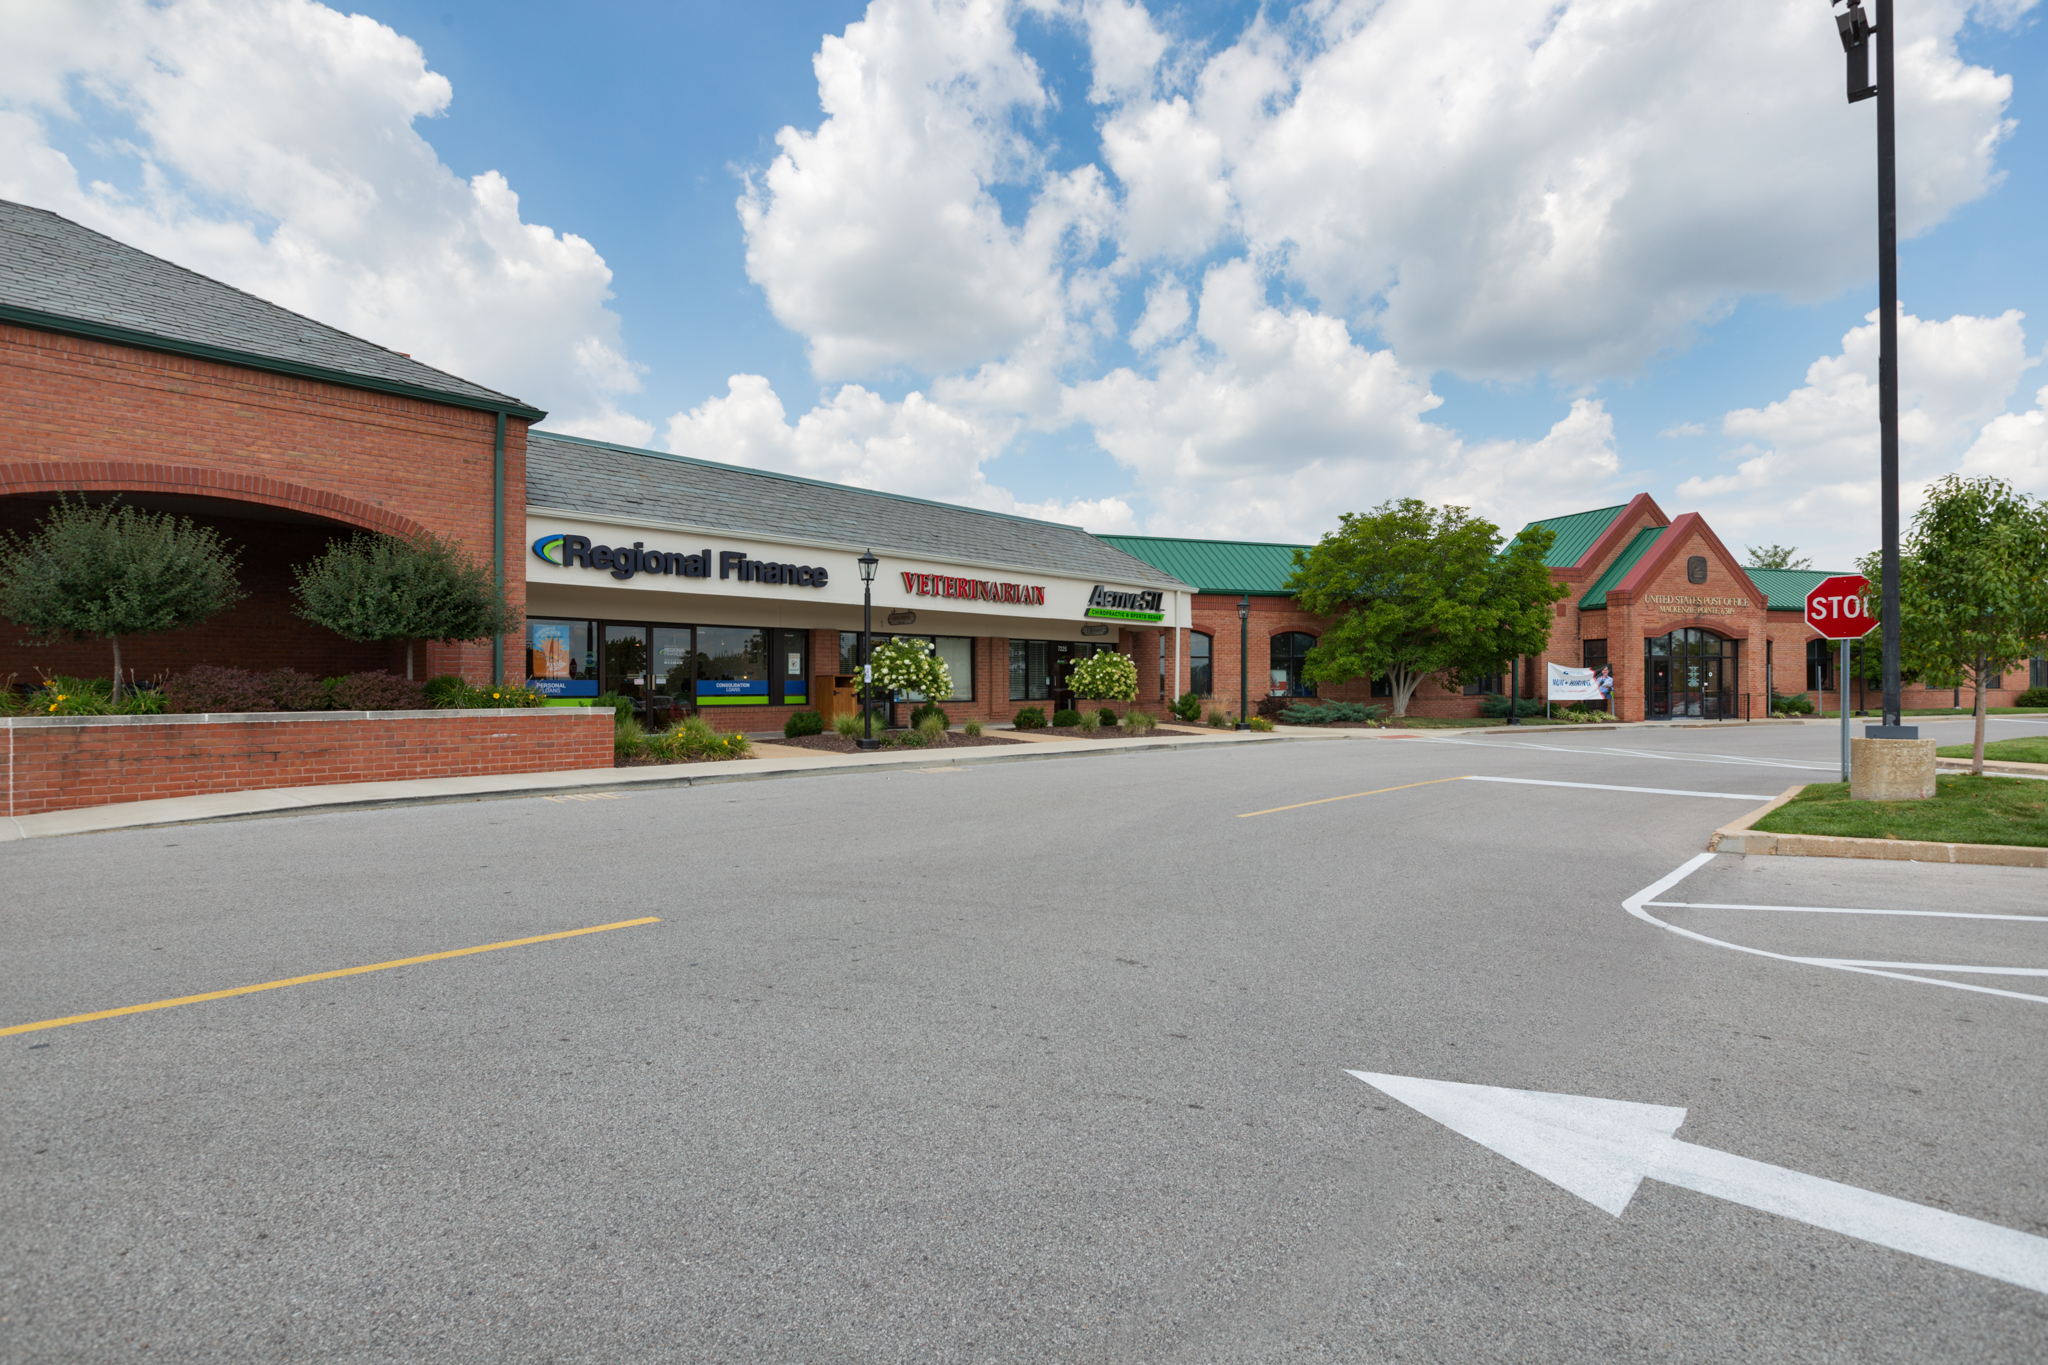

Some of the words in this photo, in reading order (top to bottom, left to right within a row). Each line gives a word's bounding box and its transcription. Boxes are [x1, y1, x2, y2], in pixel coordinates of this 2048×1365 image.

[562, 534, 712, 580] Regional
[719, 550, 829, 588] Finance
[901, 571, 1046, 606] VETERINARIAN
[1644, 595, 1674, 604] UNITED
[1675, 595, 1702, 605] STATES
[1703, 596, 1721, 606] POST
[1723, 597, 1750, 607] OFFICE
[1092, 609, 1125, 618] CHIROPRACTIC
[1660, 605, 1696, 613] MACKENZIE
[1697, 606, 1719, 614] POINTE
